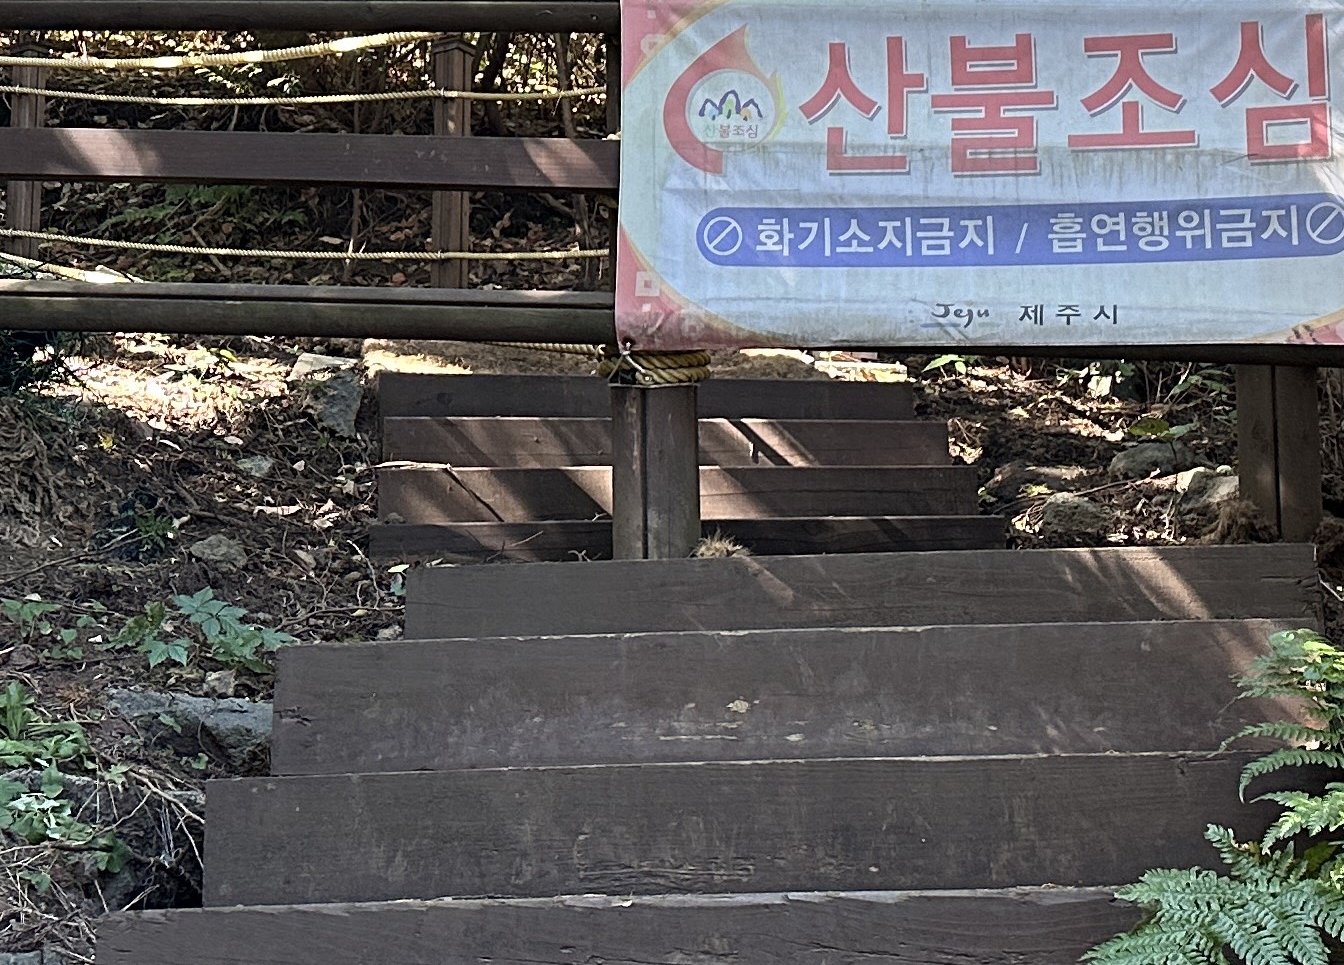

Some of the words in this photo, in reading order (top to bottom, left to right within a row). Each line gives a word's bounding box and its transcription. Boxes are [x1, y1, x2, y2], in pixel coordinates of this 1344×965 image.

[798, 12, 1335, 177] 산불조심
[703, 124, 759, 139] 산불조심
[755, 215, 995, 257] 화기소지금지
[1047, 204, 1300, 254] 흡연행위금지
[930, 303, 990, 329] Jeju
